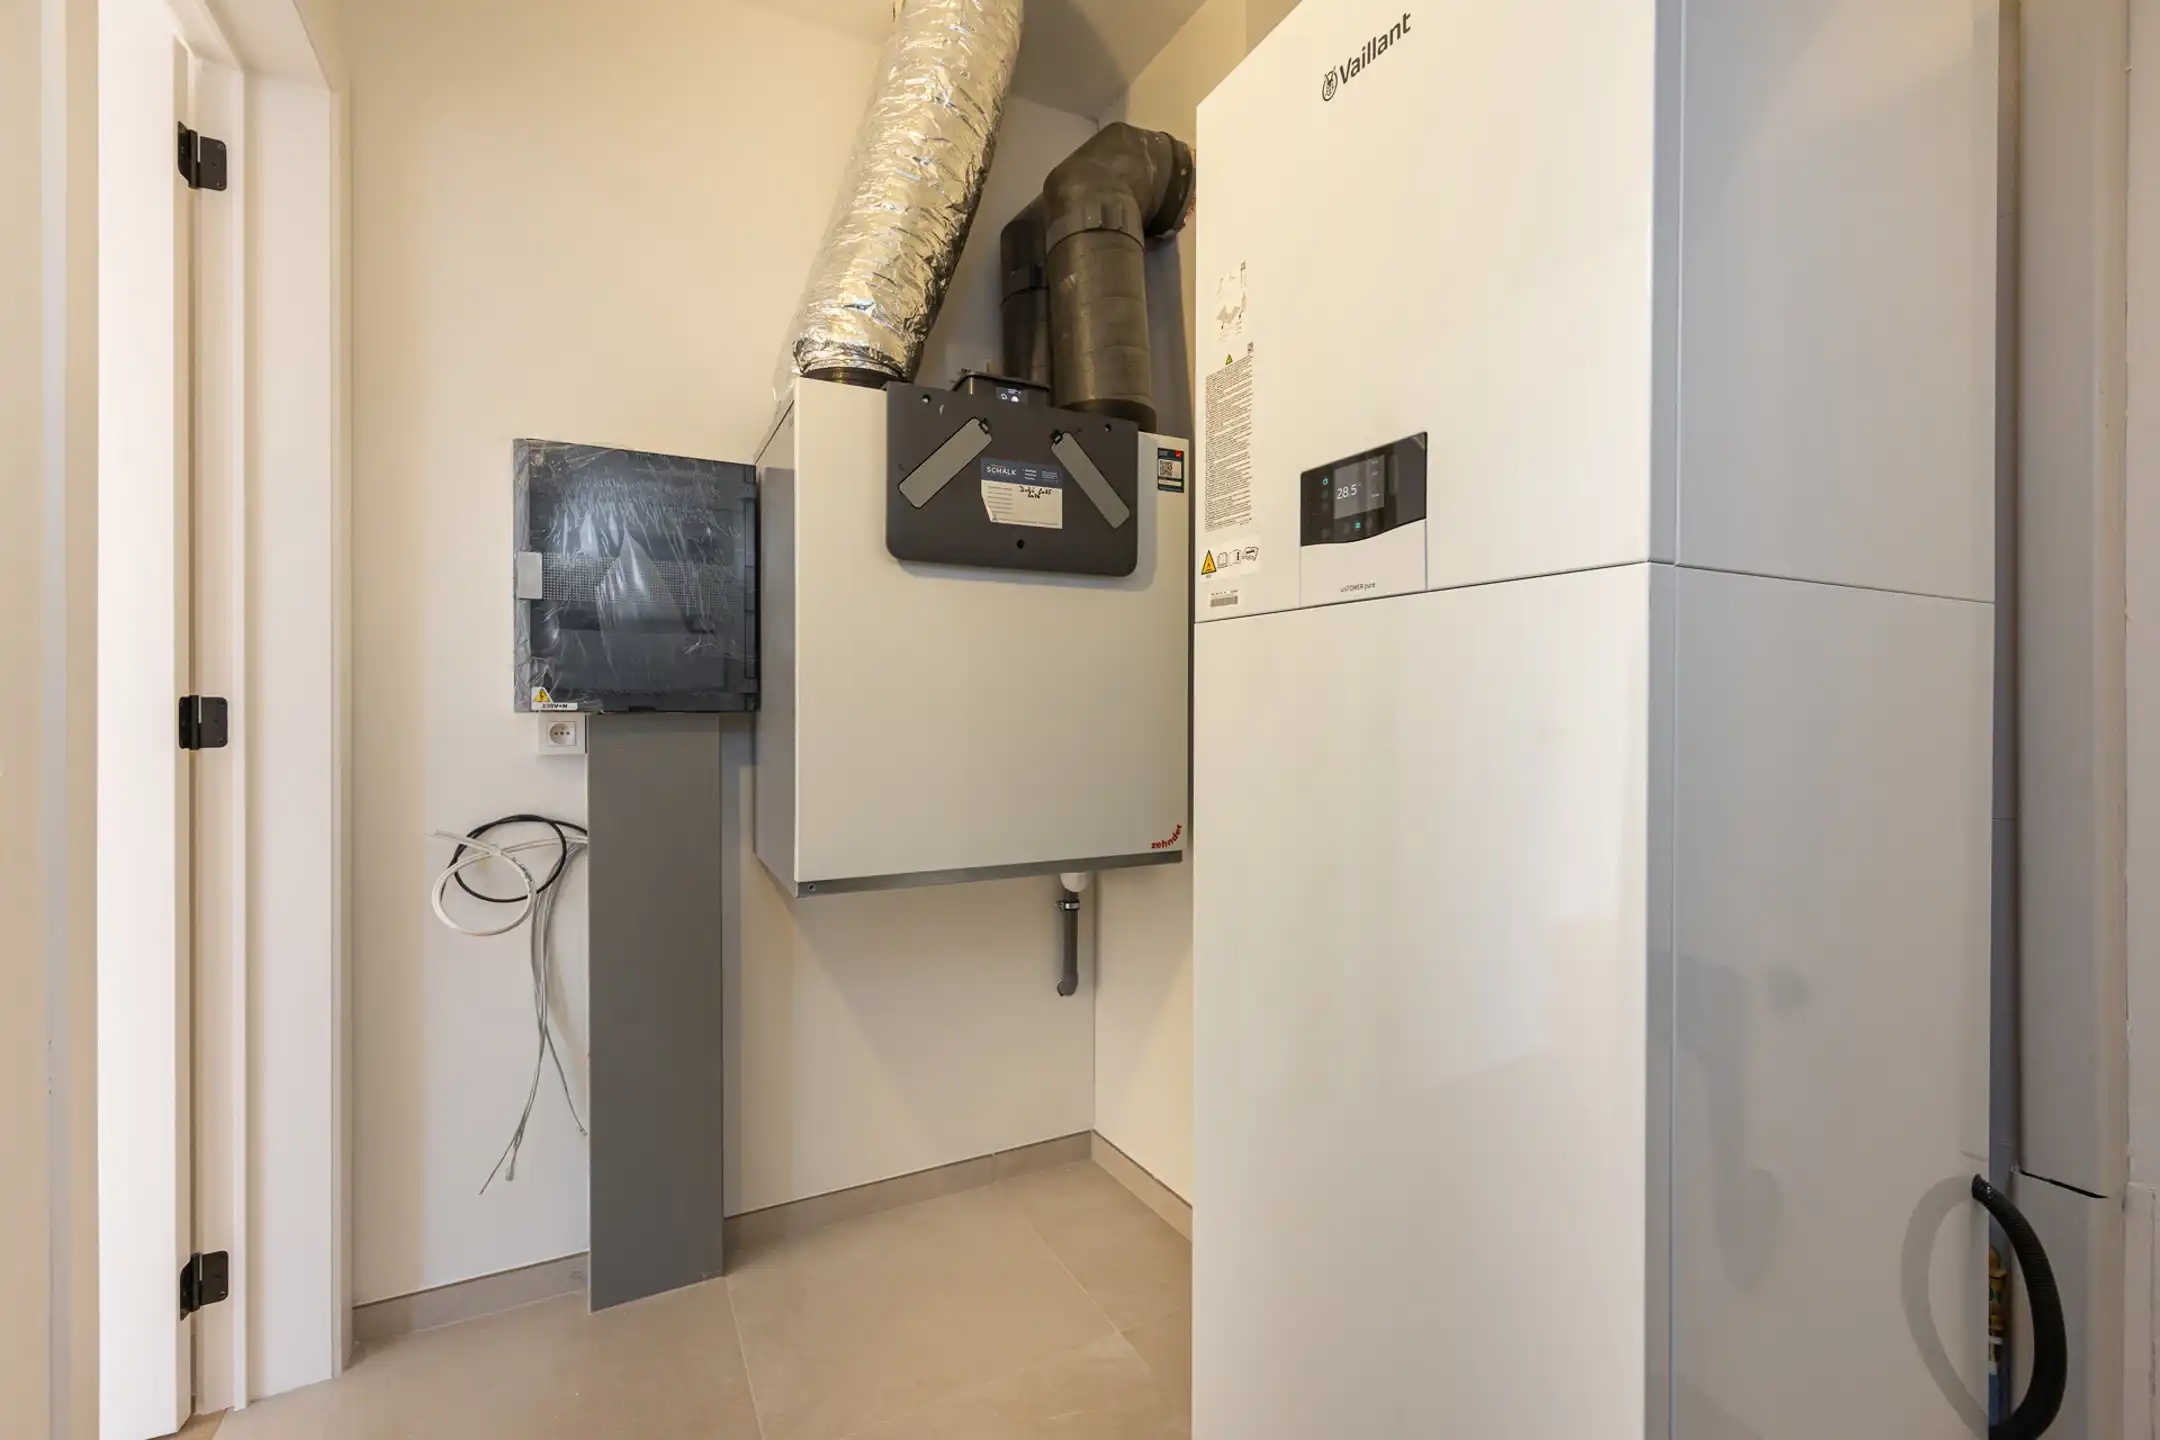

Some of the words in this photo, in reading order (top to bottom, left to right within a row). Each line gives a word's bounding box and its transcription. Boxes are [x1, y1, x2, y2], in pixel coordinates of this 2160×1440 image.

[1339, 12, 1411, 84] Vaillant
[986, 466, 1017, 476] SCHALK
[1336, 483, 1358, 500] 28.5
[1151, 824, 1183, 849] zehnder
